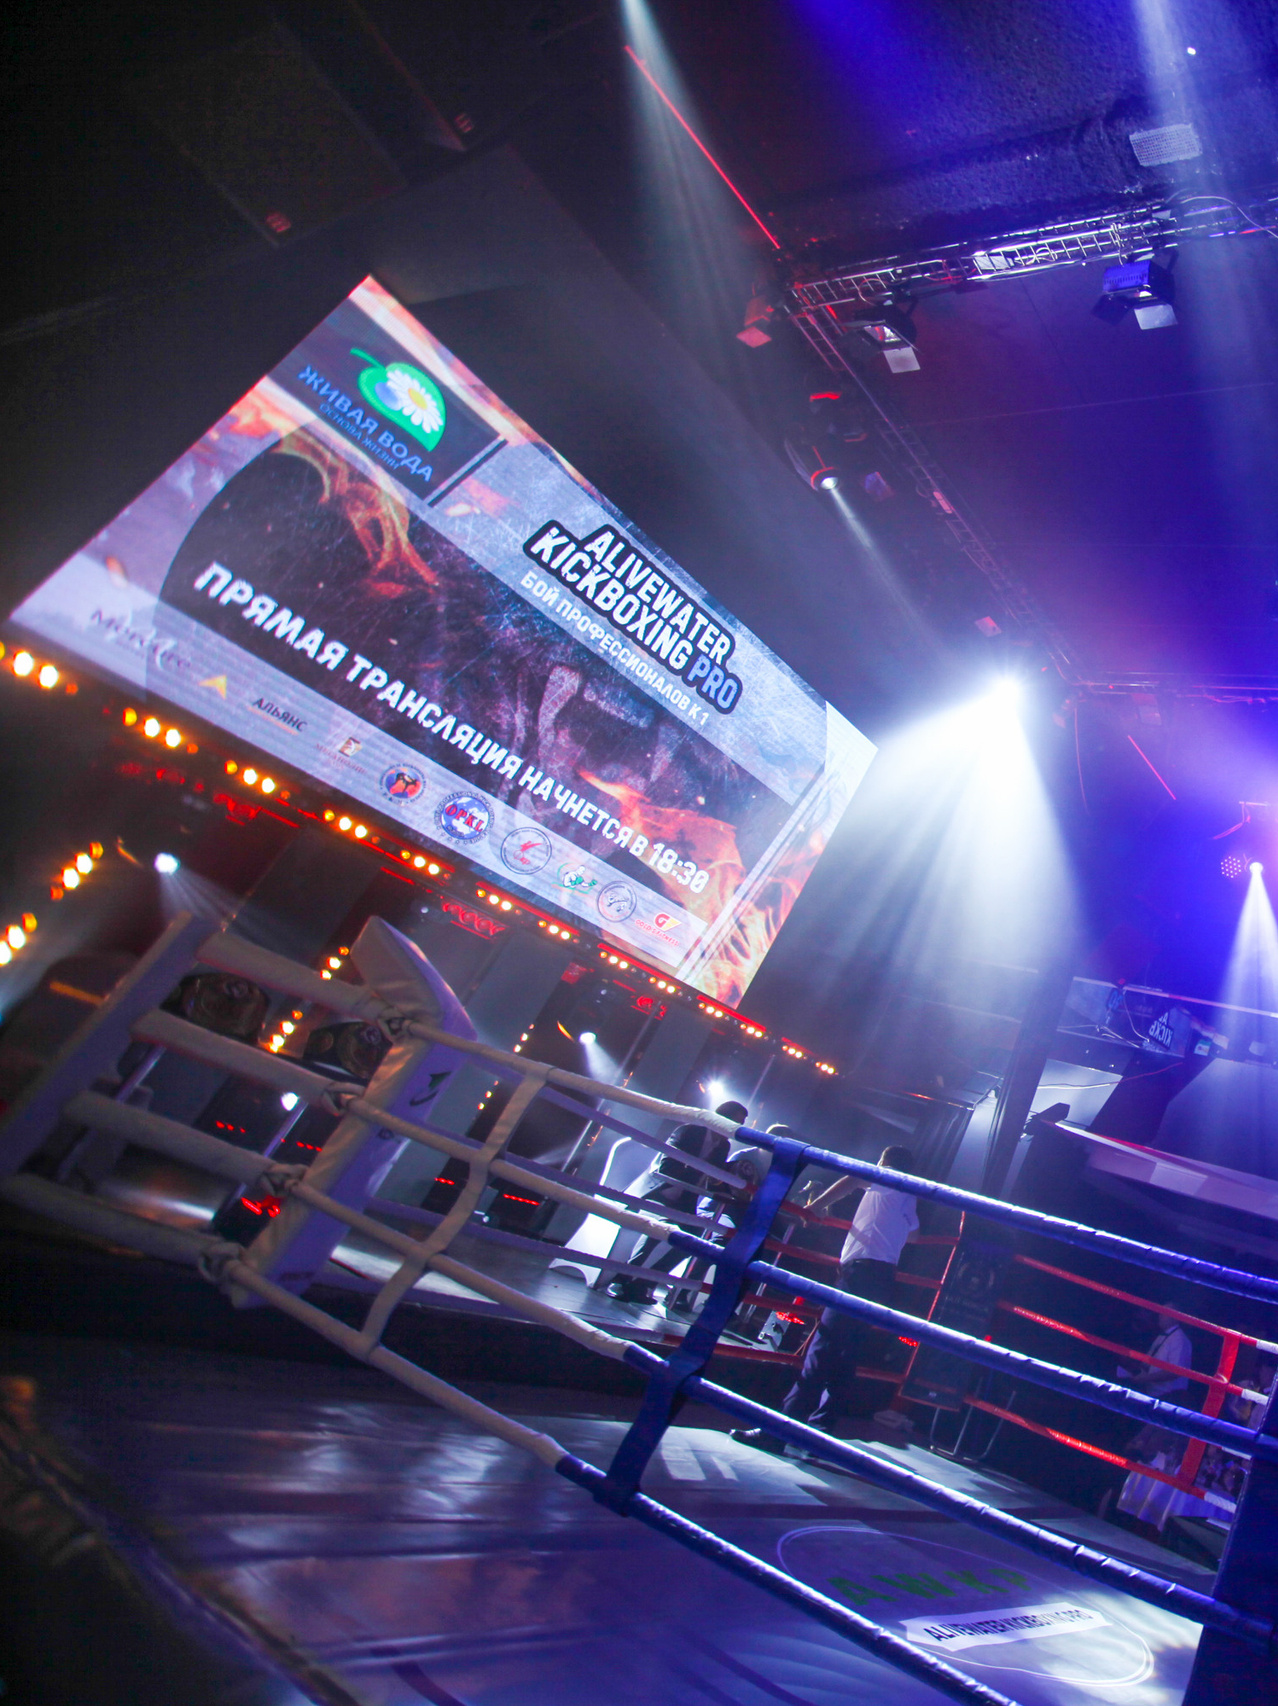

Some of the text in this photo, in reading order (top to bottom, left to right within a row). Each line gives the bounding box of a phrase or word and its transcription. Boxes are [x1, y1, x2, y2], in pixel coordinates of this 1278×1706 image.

[298, 365, 433, 482] ЖИВАЯ ВОДА
[320, 402, 400, 470] ОСНОВА ЖИЗНИ
[520, 570, 561, 607] БОЙ
[555, 598, 691, 711] ПРОФЕССИОНАЛОВ
[530, 526, 739, 709] KICKBOXING PRO
[584, 530, 731, 666] ALIVEWATER
[193, 560, 350, 671] ПРЯМАЯ
[346, 653, 524, 780] ТРАНСЛЯЦИЯ
[518, 765, 635, 848] НАЧНЕТСЯ
[629, 834, 649, 858] В
[648, 842, 710, 894] 18:30
[252, 697, 308, 733] АЛЬЯНС
[445, 803, 484, 833] OPKL
[827, 1568, 1033, 1606] AWKP
